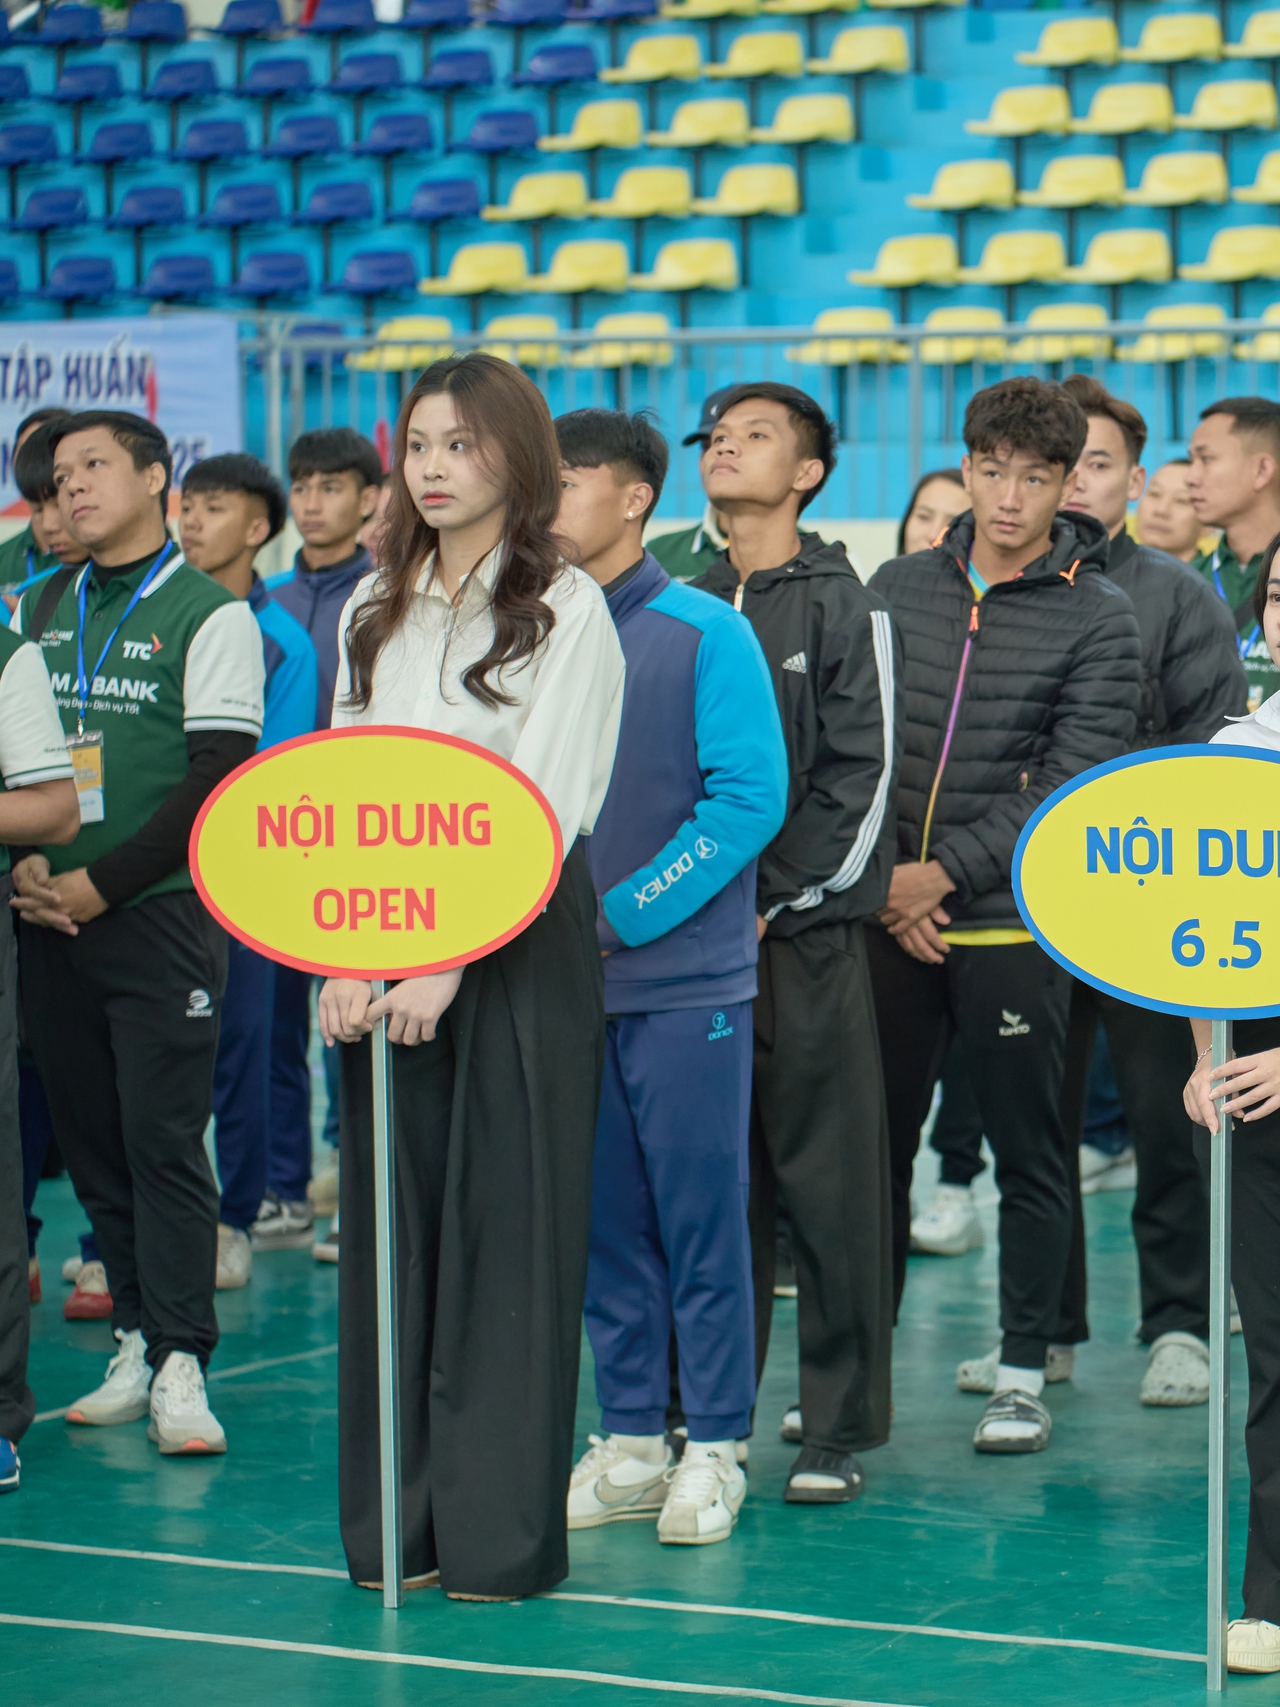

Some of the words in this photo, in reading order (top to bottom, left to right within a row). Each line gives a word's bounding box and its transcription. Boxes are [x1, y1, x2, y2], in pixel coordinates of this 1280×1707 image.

[64, 329, 148, 399] HUẤN
[122, 640, 154, 661] TTC
[91, 675, 160, 704] BANK
[257, 794, 335, 859] NỘI
[357, 803, 492, 847] DUNG
[1086, 816, 1173, 886] NỘI
[634, 852, 694, 909] DONEX
[313, 888, 436, 931] OPEN
